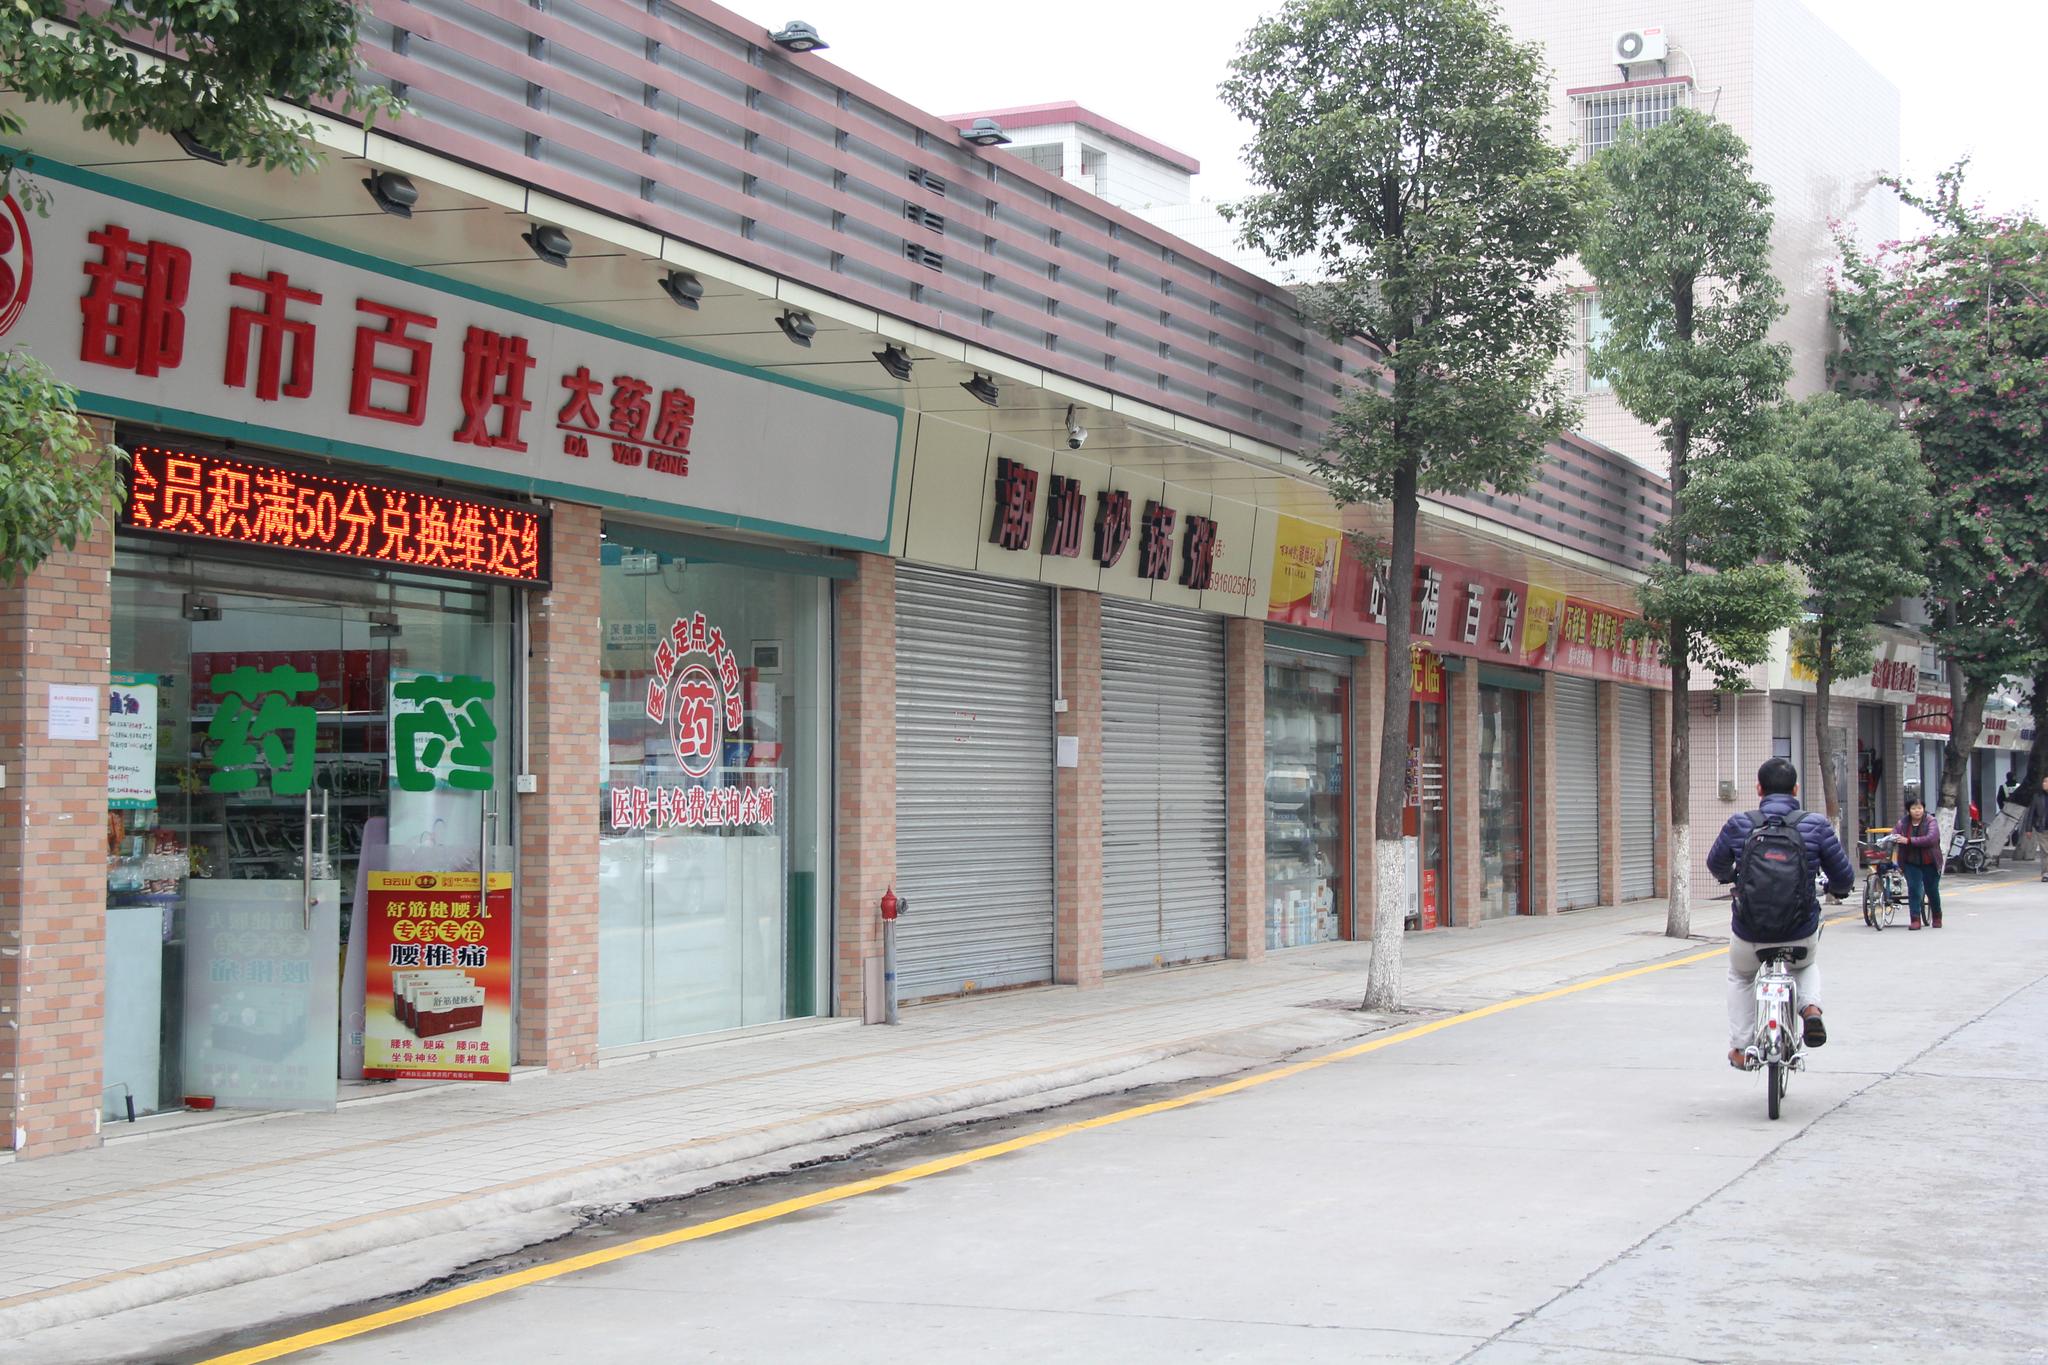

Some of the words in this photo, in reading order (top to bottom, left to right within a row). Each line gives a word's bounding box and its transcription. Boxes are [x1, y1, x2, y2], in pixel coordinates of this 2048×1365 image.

[81, 224, 536, 452] 都市百姓
[558, 366, 695, 447] 大药房
[564, 435, 588, 457] DA
[612, 442, 642, 466] YAO
[647, 449, 688, 476] FANG
[646, 612, 743, 732] 医保定点大药房
[208, 665, 319, 794] 药
[678, 680, 715, 757] 药
[612, 786, 774, 829] 医保卡免费查询余额
[386, 901, 492, 919] 舒筋健腰丸
[394, 921, 484, 941] 专药专治
[389, 943, 488, 968] 腰椎痛
[391, 1053, 438, 1063] 坐骨神经
[454, 1054, 490, 1065] 腰椎痛
[456, 1040, 490, 1051] 腰间盘
